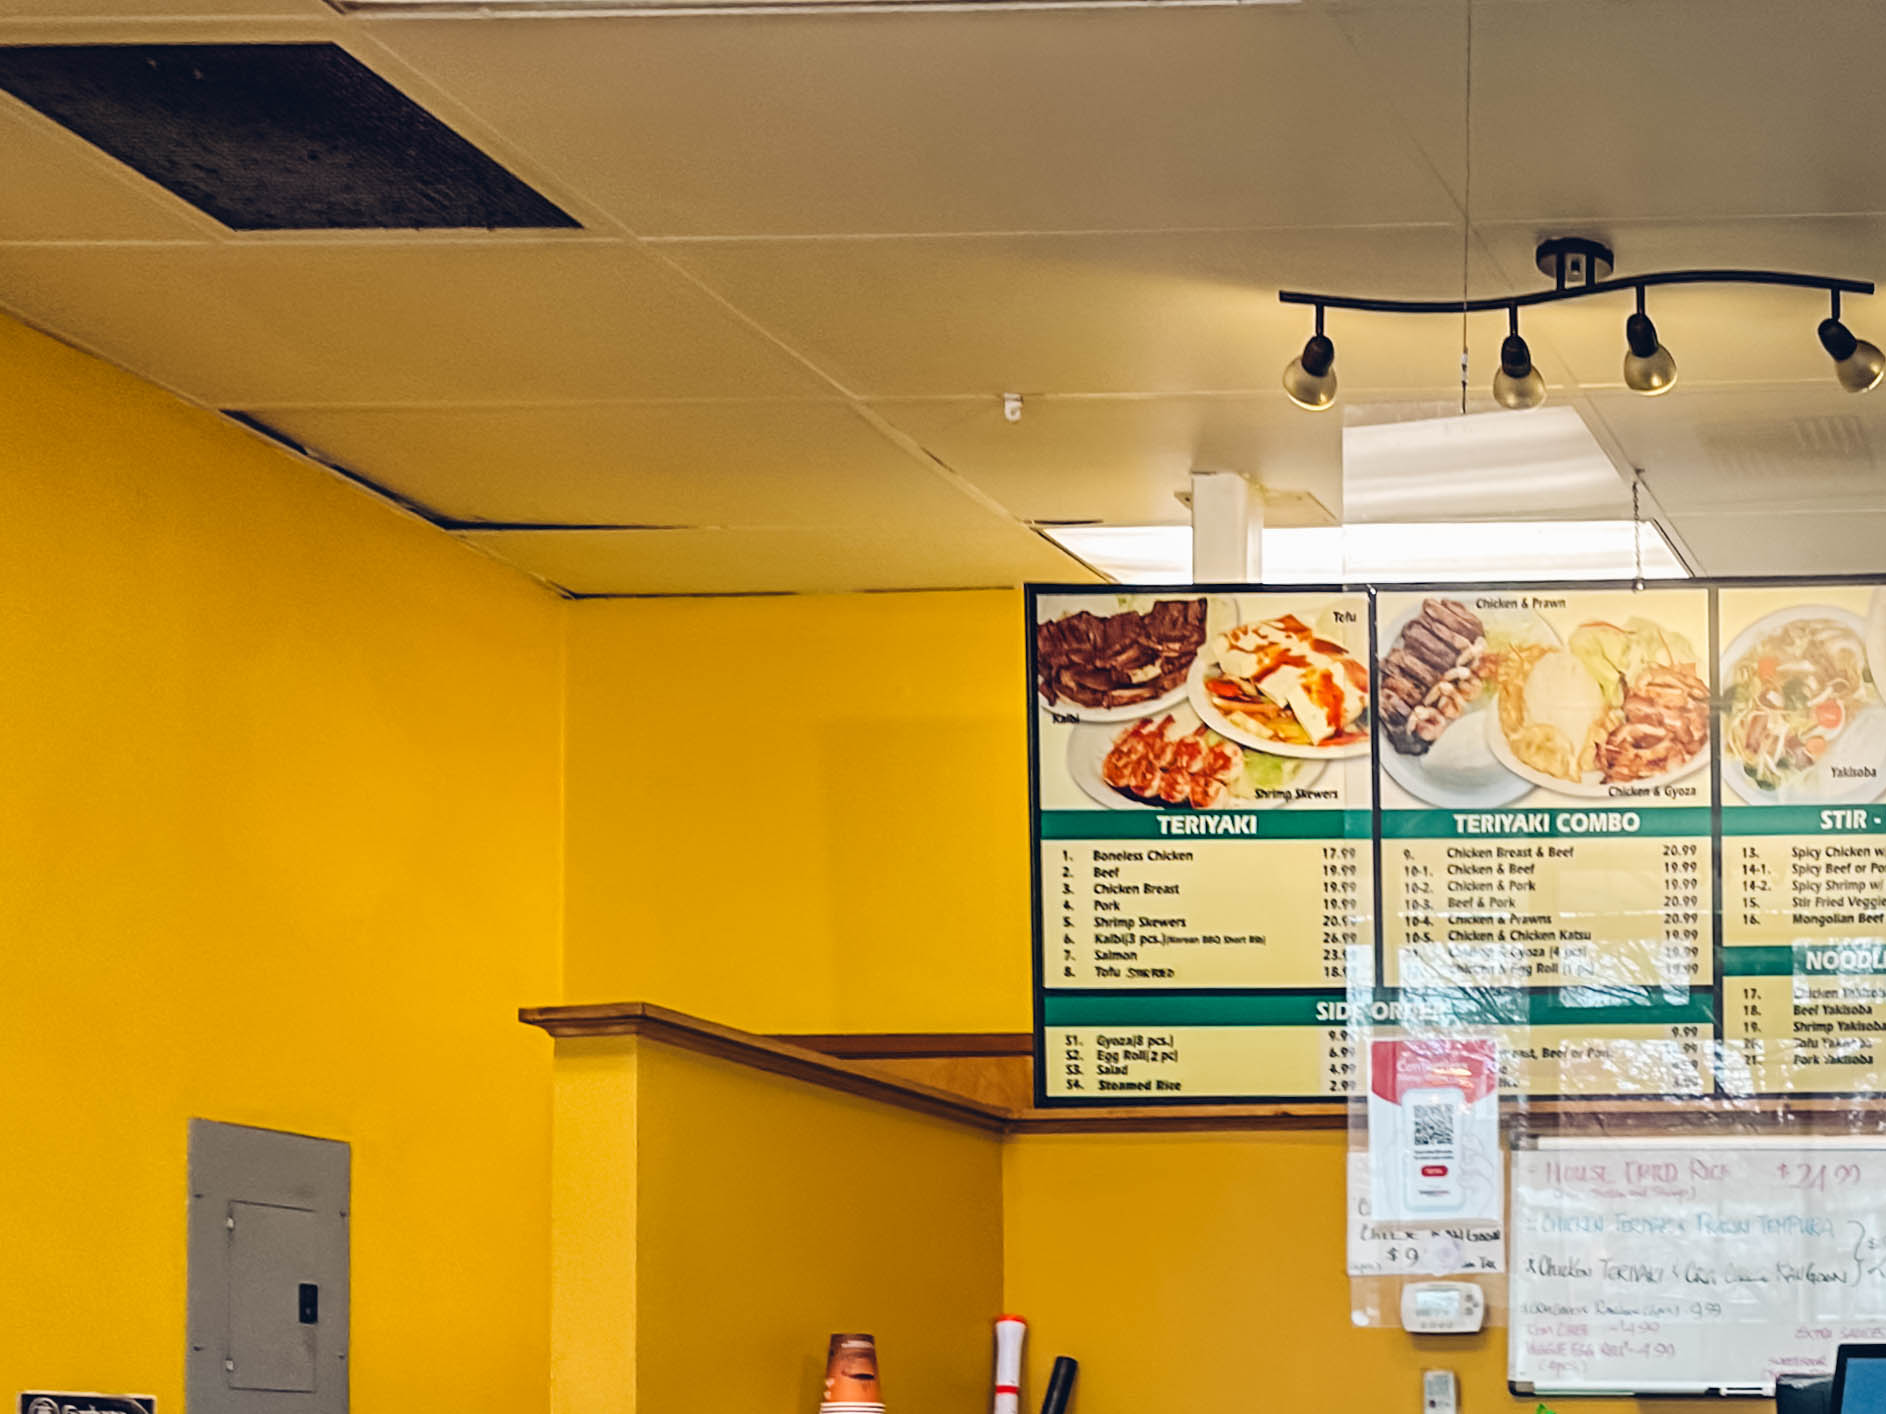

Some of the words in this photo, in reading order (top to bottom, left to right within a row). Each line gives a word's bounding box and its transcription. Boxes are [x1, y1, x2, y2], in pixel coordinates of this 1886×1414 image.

[1476, 598, 1516, 610] Chicken
[1520, 599, 1528, 609] &
[1531, 598, 1566, 609] Prawn
[1333, 612, 1357, 624] Tofu
[1052, 713, 1080, 724] Kalbi
[1830, 766, 1877, 780] Yakisoba
[1255, 788, 1291, 801] Shrimp
[1295, 788, 1339, 800] Skewers
[1609, 785, 1649, 798] Chicken
[1653, 787, 1662, 796] &
[1665, 786, 1697, 799] Gyoza
[1157, 815, 1257, 834] TERIYAKI
[1454, 814, 1550, 834] TERIYAKI
[1556, 813, 1641, 832] COMBO
[1820, 809, 1867, 829] STIR
[1093, 850, 1143, 861] Boneless
[1148, 850, 1193, 861] Chicken
[1447, 848, 1493, 859] Chicken
[1497, 848, 1532, 858] Breast
[1536, 848, 1544, 857] &
[1548, 848, 1574, 857] Beef
[1792, 847, 1822, 859] Spicy
[1825, 847, 1871, 858] Chicken
[1094, 867, 1119, 878] Beef
[1448, 865, 1493, 875] Chicken
[1497, 865, 1505, 875] &
[1509, 864, 1535, 875] Beef
[1792, 863, 1822, 875] Spicy
[1825, 863, 1851, 874] Beef
[1855, 866, 1866, 874] or
[1094, 883, 1140, 895] Chicken
[1144, 884, 1180, 895] Breast
[1448, 881, 1494, 892] Chicken
[1497, 881, 1505, 891] &
[1509, 881, 1536, 891] Pork
[1792, 880, 1822, 892] Spicy
[1825, 880, 1866, 892] Shrimp
[1094, 900, 1120, 911] Pork
[1448, 898, 1474, 909] Beef
[1477, 898, 1485, 908] &
[1489, 898, 1515, 908] Pork
[1792, 897, 1812, 908] Stir
[1816, 897, 1845, 908] Fried
[1094, 917, 1135, 929] Shrimp
[1139, 917, 1186, 928] Skewers
[1792, 913, 1854, 927] Mongolian
[1858, 913, 1884, 923] Beef
[1448, 931, 1494, 942] Chicken
[1498, 931, 1506, 941] &
[1510, 930, 1556, 941] Chicken
[1559, 930, 1591, 941] Katsu
[1095, 950, 1137, 961] Salmon
[1096, 967, 1120, 978] Tofu
[1794, 1005, 1819, 1015] Beef
[1823, 1005, 1872, 1015] Yakisoba
[1793, 1022, 1834, 1033] Shrimp
[1097, 1051, 1119, 1063] Egg
[1097, 1065, 1128, 1075] Salad
[1098, 1081, 1151, 1091] Steamed
[1155, 1081, 1181, 1091] Rice
